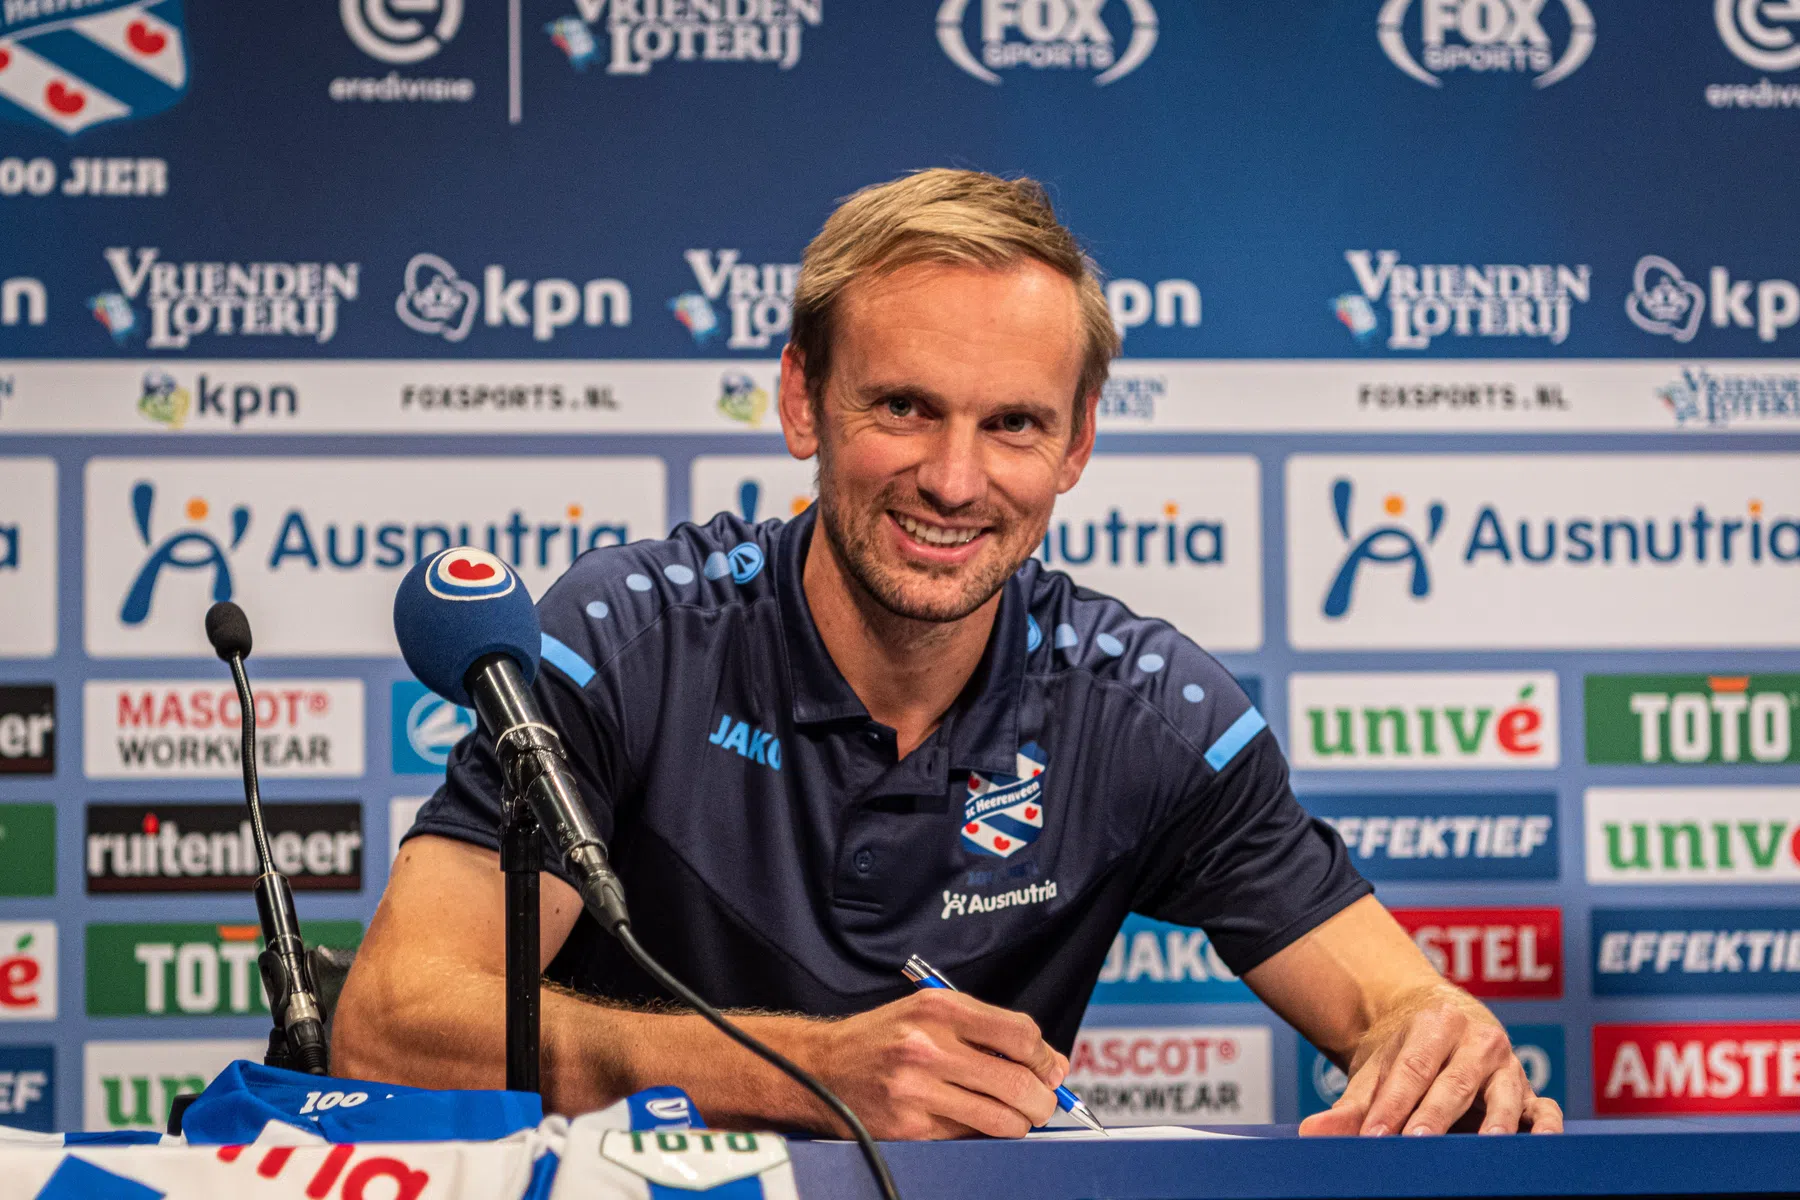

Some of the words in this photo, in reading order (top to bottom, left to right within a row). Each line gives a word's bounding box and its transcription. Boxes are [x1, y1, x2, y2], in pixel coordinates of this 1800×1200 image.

[980, 0, 1112, 44] FOX
[1422, 0, 1552, 45] FOX
[606, 21, 802, 75] LOTERIJ
[983, 42, 1114, 69] SPORTS
[1424, 45, 1552, 72] SPORTS
[328, 71, 475, 102] eredivisie
[62, 158, 168, 195] JIER
[106, 248, 361, 300] VRIENDEN
[1345, 250, 1591, 301] VRIENDEN
[148, 297, 338, 349] LOTERIJ
[485, 265, 631, 341] kpn
[1107, 278, 1201, 341] pn
[1387, 298, 1572, 349] LOTERIJ
[1709, 266, 1800, 341] kp
[197, 372, 298, 424] kpn
[402, 385, 618, 411] FOXSPORTS.NL
[1359, 384, 1569, 409] FOXSPORTS.NL
[1306, 684, 1545, 757] univé
[1630, 692, 1790, 762] TOTO
[976, 781, 1040, 813] Heerenveen
[1325, 815, 1552, 859] FFEKTIEF
[1603, 820, 1800, 870] univ
[967, 880, 1057, 914] Ausnutria
[135, 942, 268, 1013] TOT
[1414, 926, 1553, 982] STEL
[1604, 1040, 1800, 1099] AMSTE
[299, 1091, 369, 1114] 100
